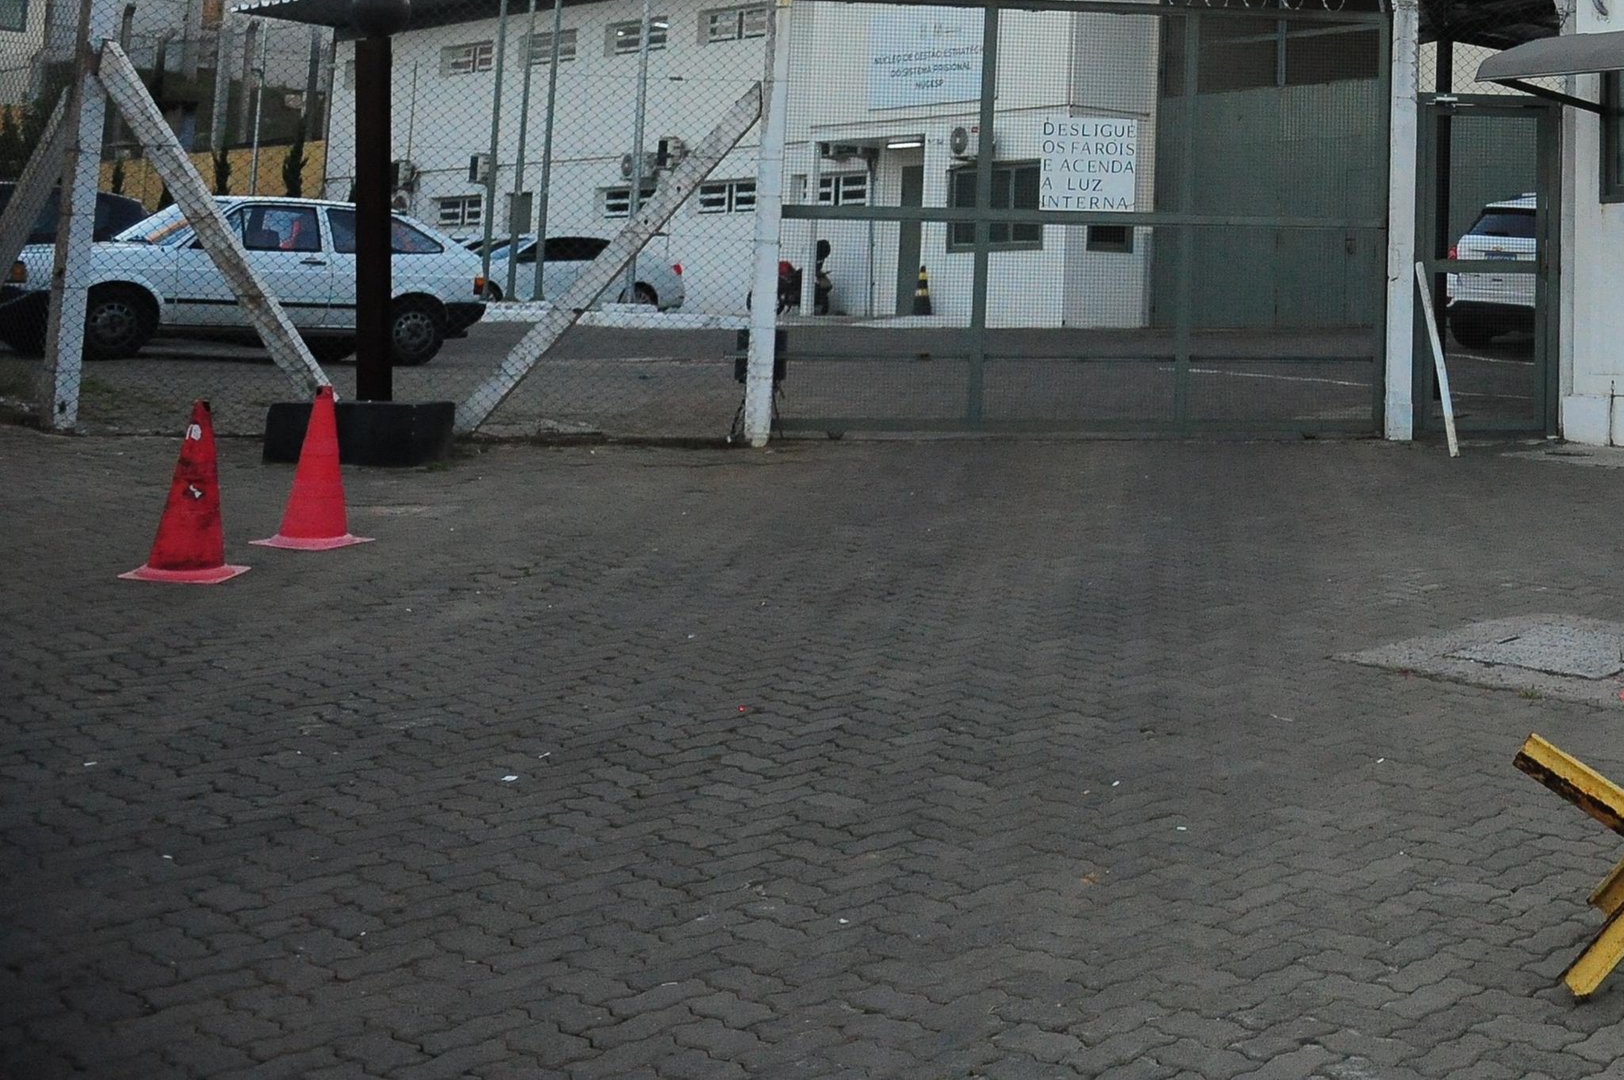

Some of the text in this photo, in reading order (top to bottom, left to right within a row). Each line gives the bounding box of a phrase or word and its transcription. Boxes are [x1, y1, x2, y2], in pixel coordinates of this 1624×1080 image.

[1043, 122, 1136, 138] DESLIGUE
[1042, 140, 1065, 154] OS
[1043, 159, 1134, 173] E ACENDA
[1041, 176, 1103, 191] A LUZ
[1041, 195, 1128, 209] INTERNA
